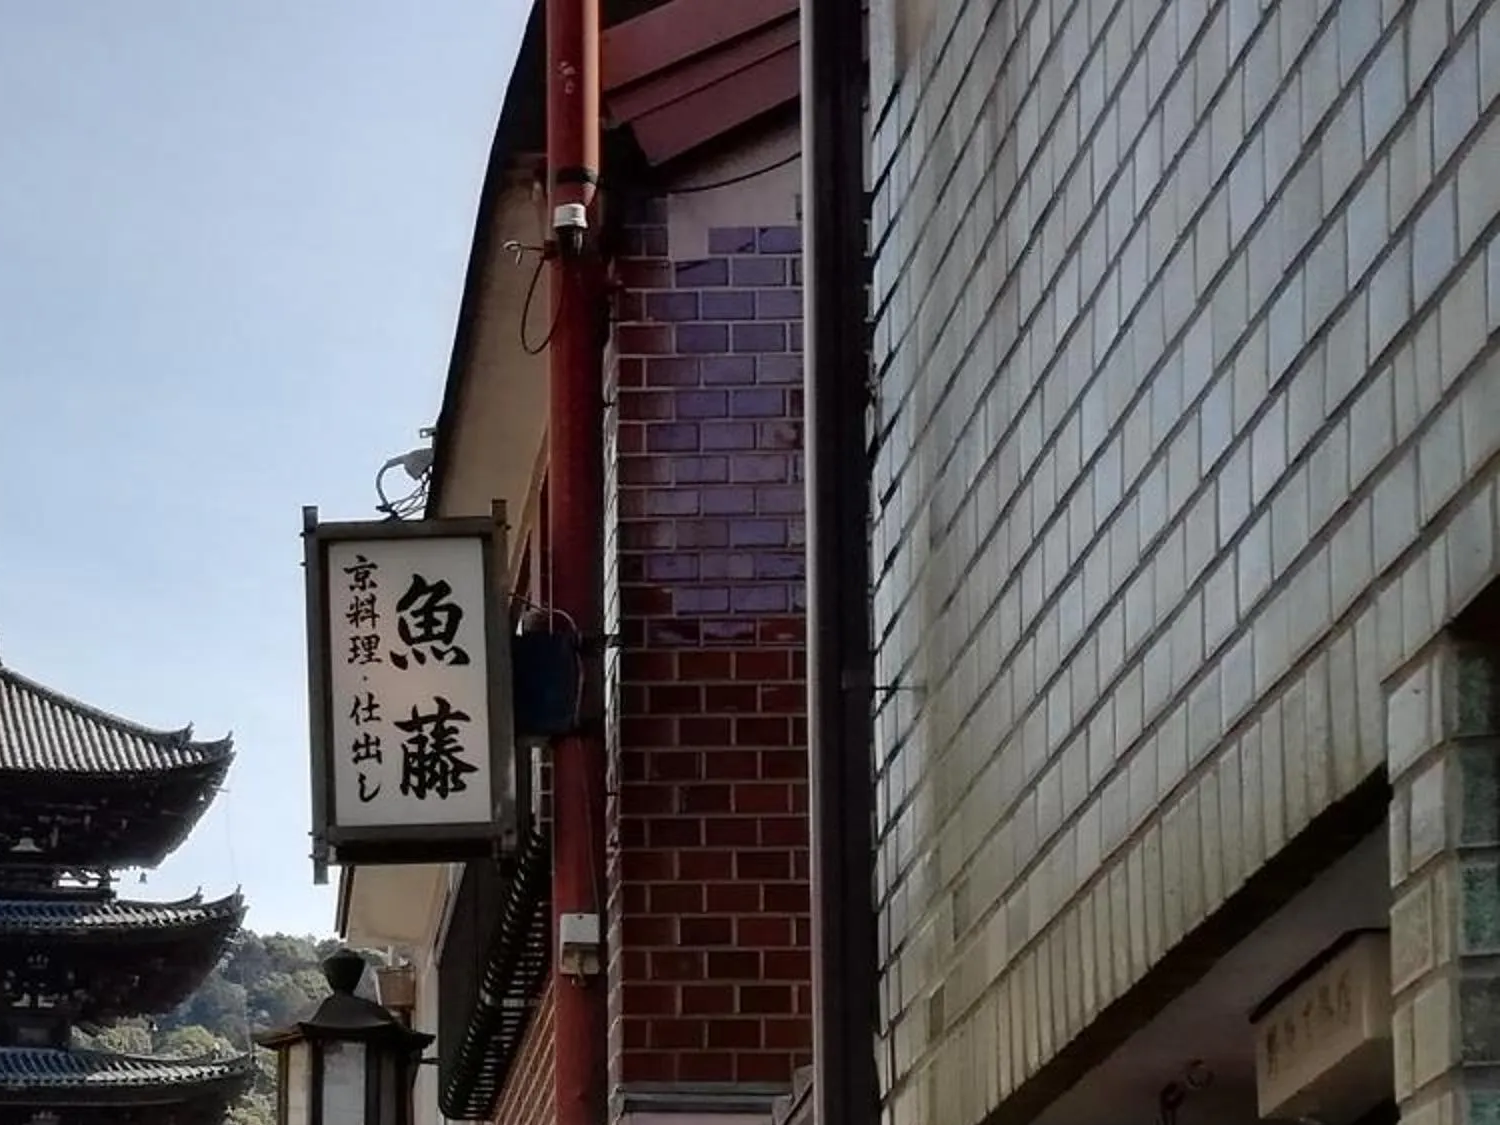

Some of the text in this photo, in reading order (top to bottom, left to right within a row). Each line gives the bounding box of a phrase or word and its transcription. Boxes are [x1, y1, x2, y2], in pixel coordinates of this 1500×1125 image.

[342, 554, 384, 802] 京料理・仕出し
[389, 573, 479, 800] 魚藤
